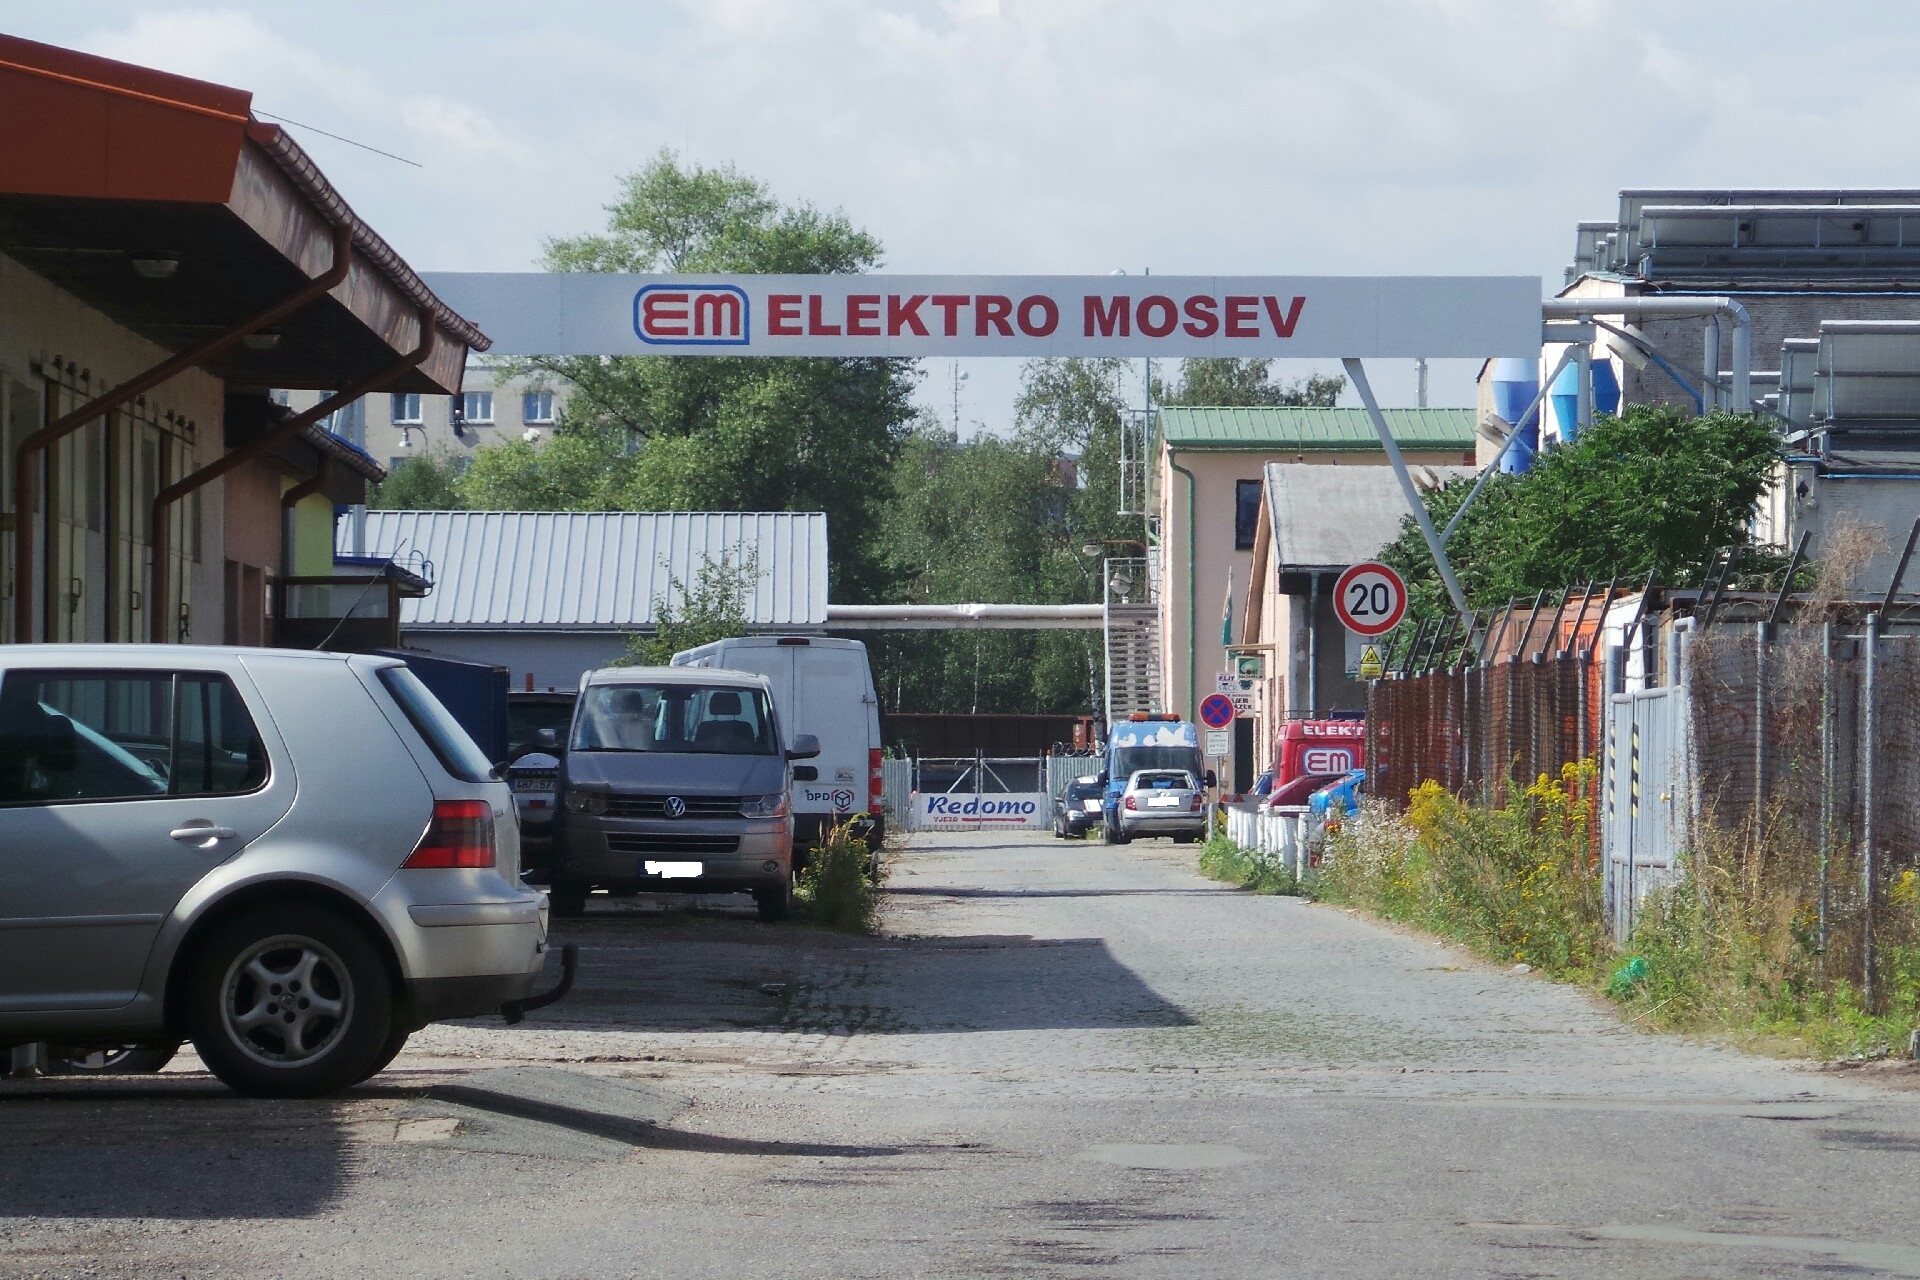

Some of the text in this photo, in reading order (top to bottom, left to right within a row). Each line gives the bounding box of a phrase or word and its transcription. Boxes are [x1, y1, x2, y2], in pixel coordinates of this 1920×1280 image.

[767, 294, 1060, 337] ELEKTRO
[1083, 295, 1306, 338] MOSEV
[1350, 582, 1389, 616] 20
[1303, 725, 1366, 736] ELEKT
[806, 791, 830, 801] DPD
[927, 796, 1036, 815] Redomo
